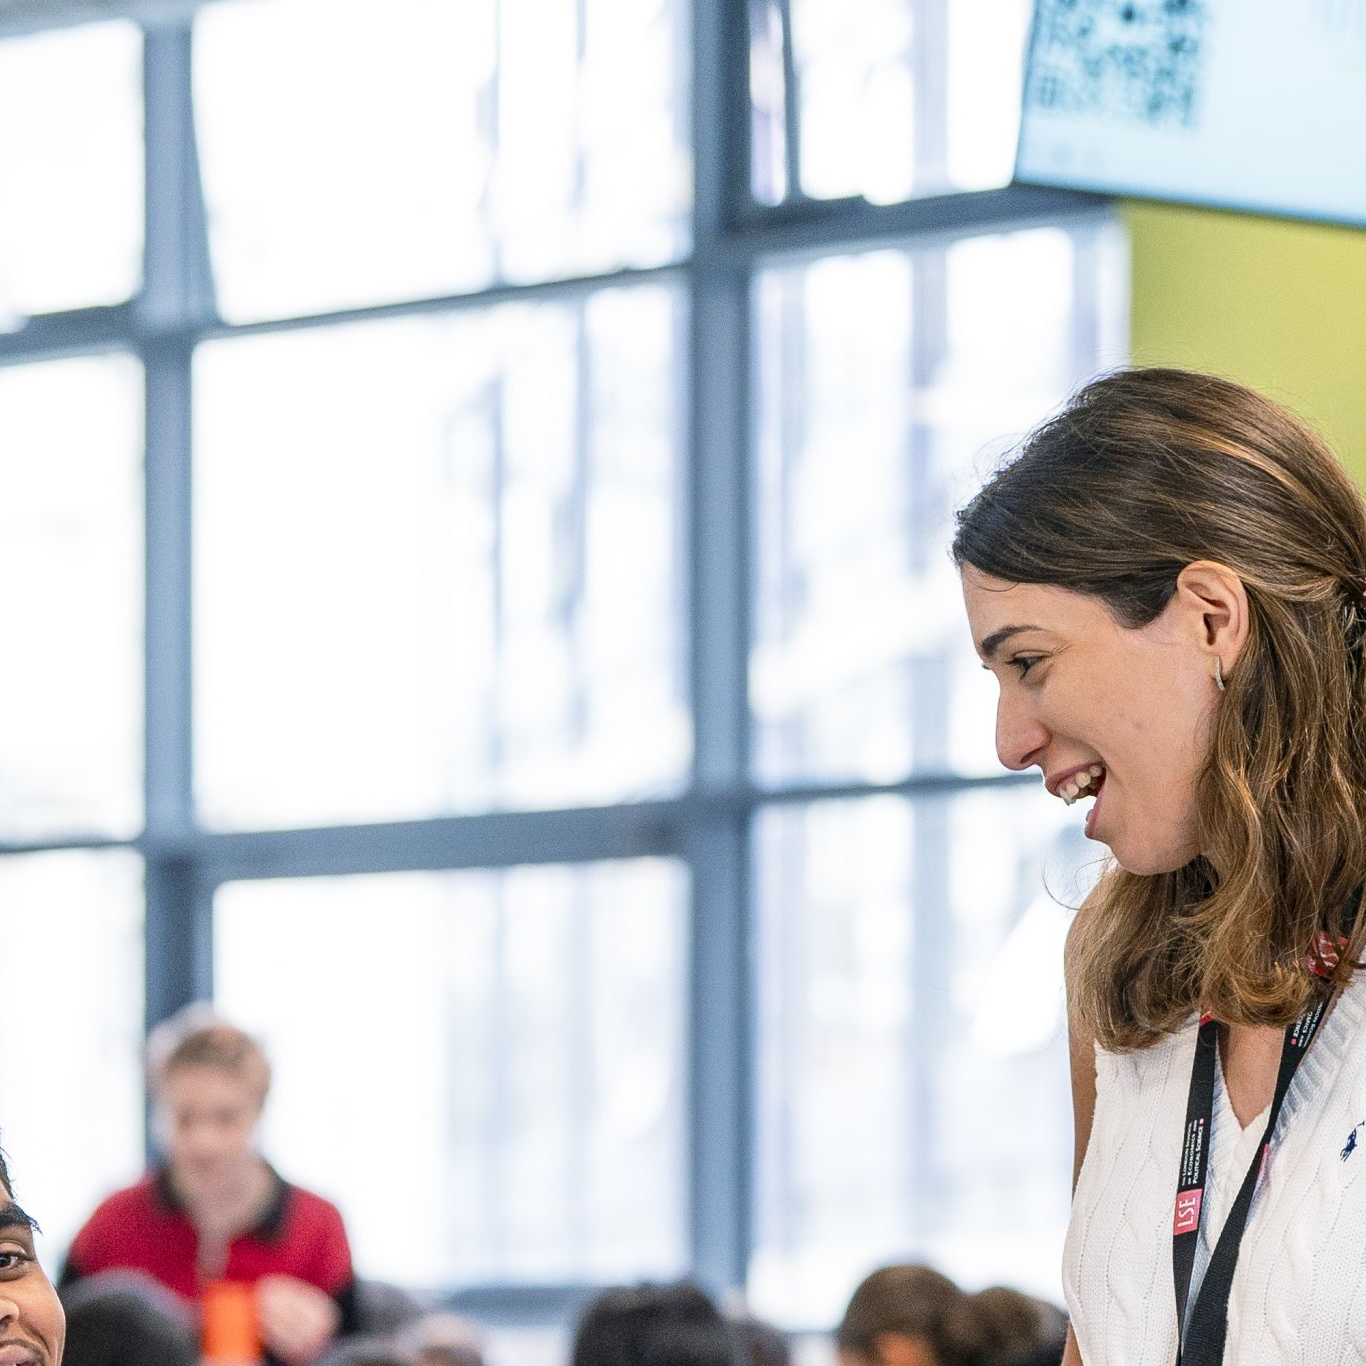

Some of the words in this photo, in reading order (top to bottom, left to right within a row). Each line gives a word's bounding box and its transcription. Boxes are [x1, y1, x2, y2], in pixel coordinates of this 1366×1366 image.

[1187, 1133, 1196, 1176] ECONOMICS
[1195, 1126, 1203, 1152] SCIENCE
[1192, 1152, 1200, 1185] POLITICAL
[1177, 1197, 1196, 1227] LSE
